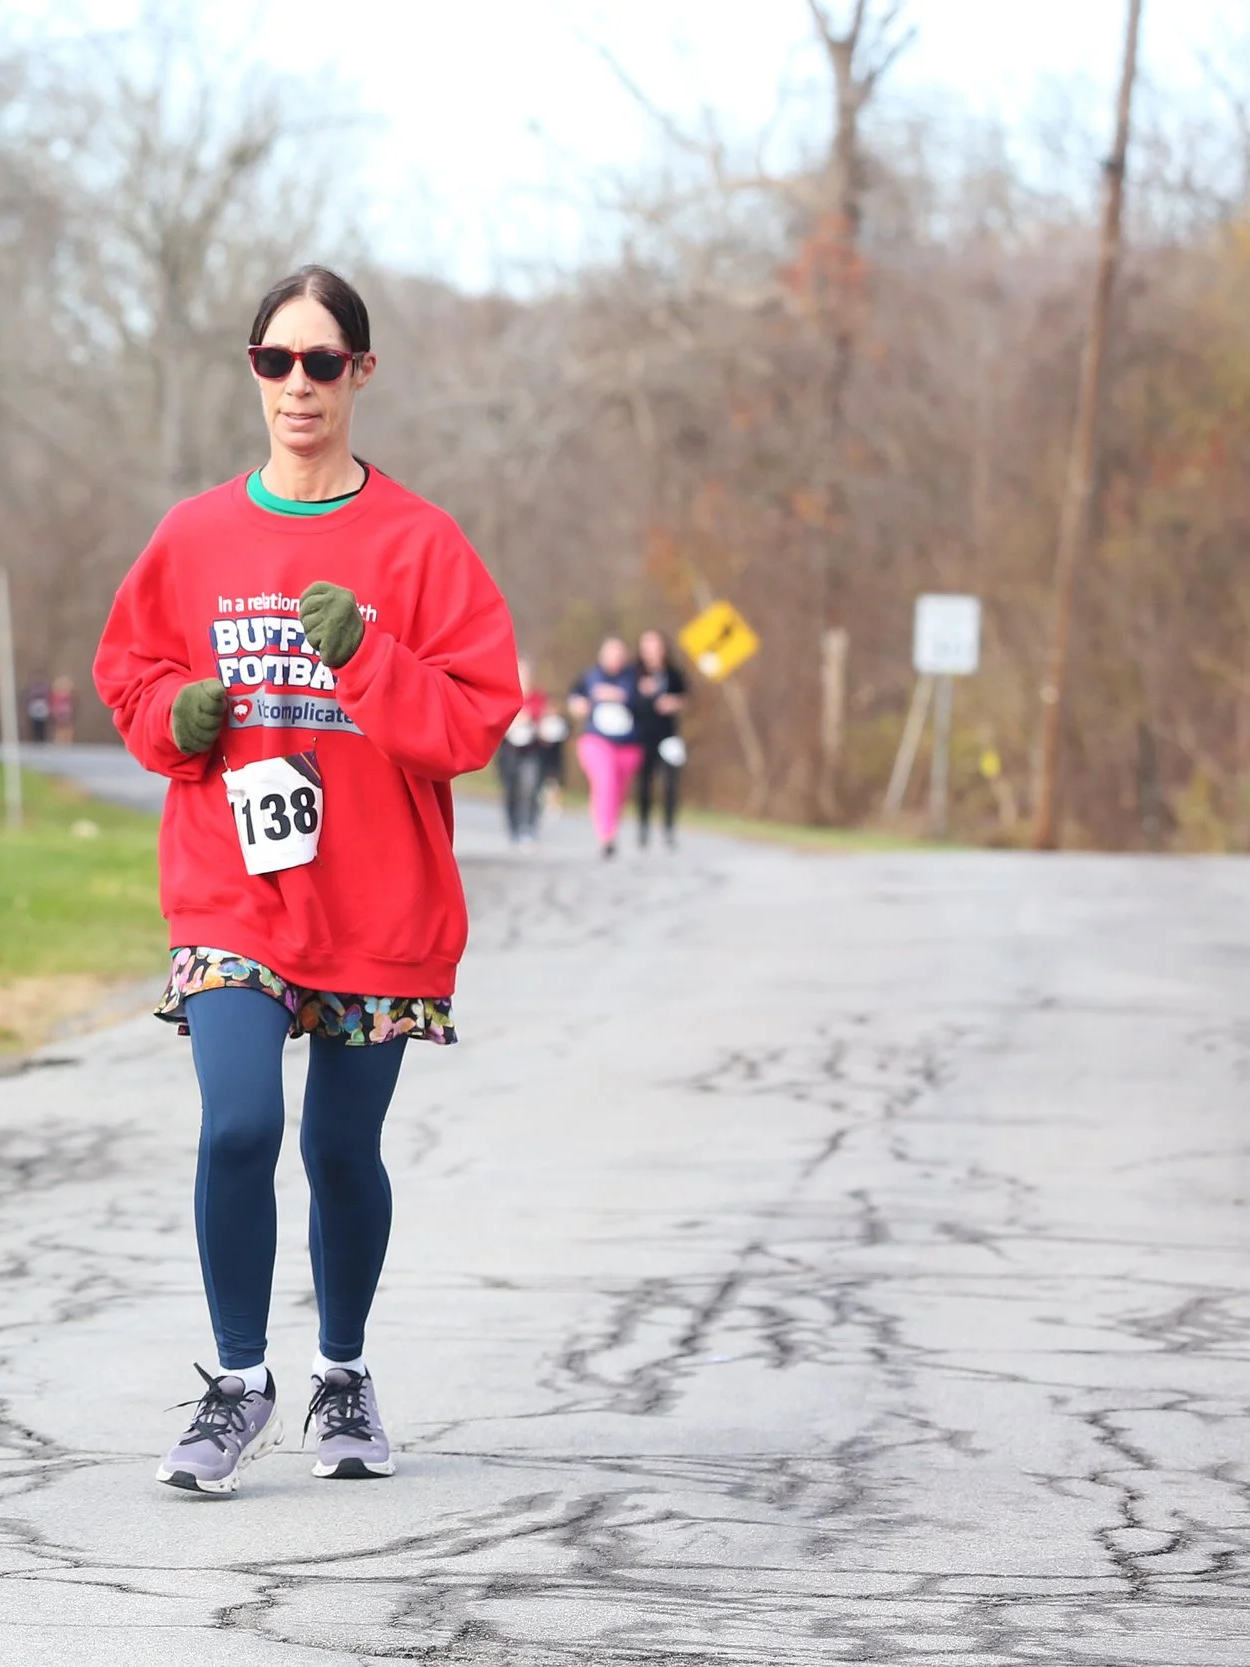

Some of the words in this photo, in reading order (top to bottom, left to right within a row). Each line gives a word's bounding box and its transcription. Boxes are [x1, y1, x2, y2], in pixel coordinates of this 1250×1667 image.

[218, 595, 232, 613] In
[235, 598, 245, 613] a
[231, 787, 318, 845] 138
